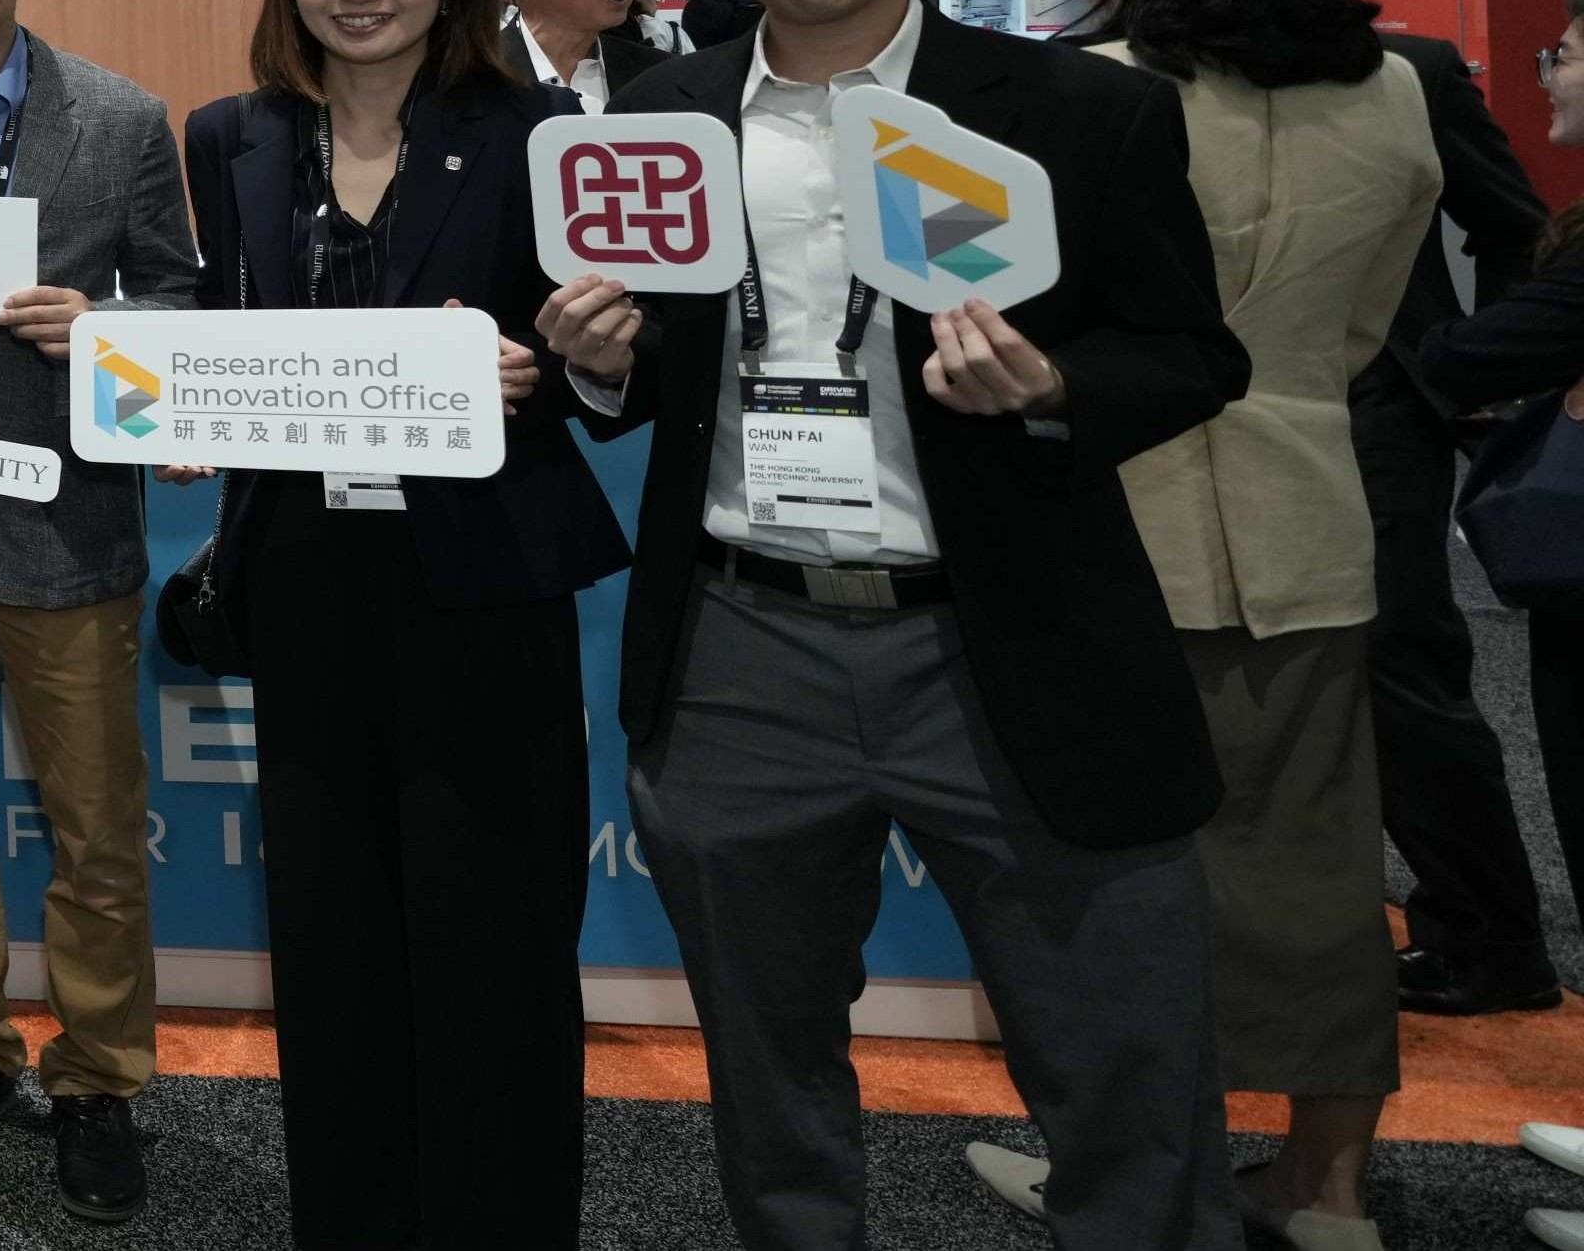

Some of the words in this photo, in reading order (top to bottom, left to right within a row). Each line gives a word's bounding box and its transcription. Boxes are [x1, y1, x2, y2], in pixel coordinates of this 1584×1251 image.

[171, 351, 321, 377] Research
[332, 353, 398, 377] and
[172, 382, 349, 410] Innovation
[360, 384, 471, 413] Office
[173, 419, 473, 450] 研究及創新事務處
[748, 428, 792, 441] CHUN
[798, 430, 822, 442] FAI
[748, 443, 777, 452] WAN
[749, 463, 765, 471] THE
[768, 465, 793, 473] HONG
[795, 466, 821, 474] KONG
[749, 472, 809, 482] POLYTECHNIC
[812, 475, 864, 485] UNIVERSITY
[6, 805, 169, 864] FR
